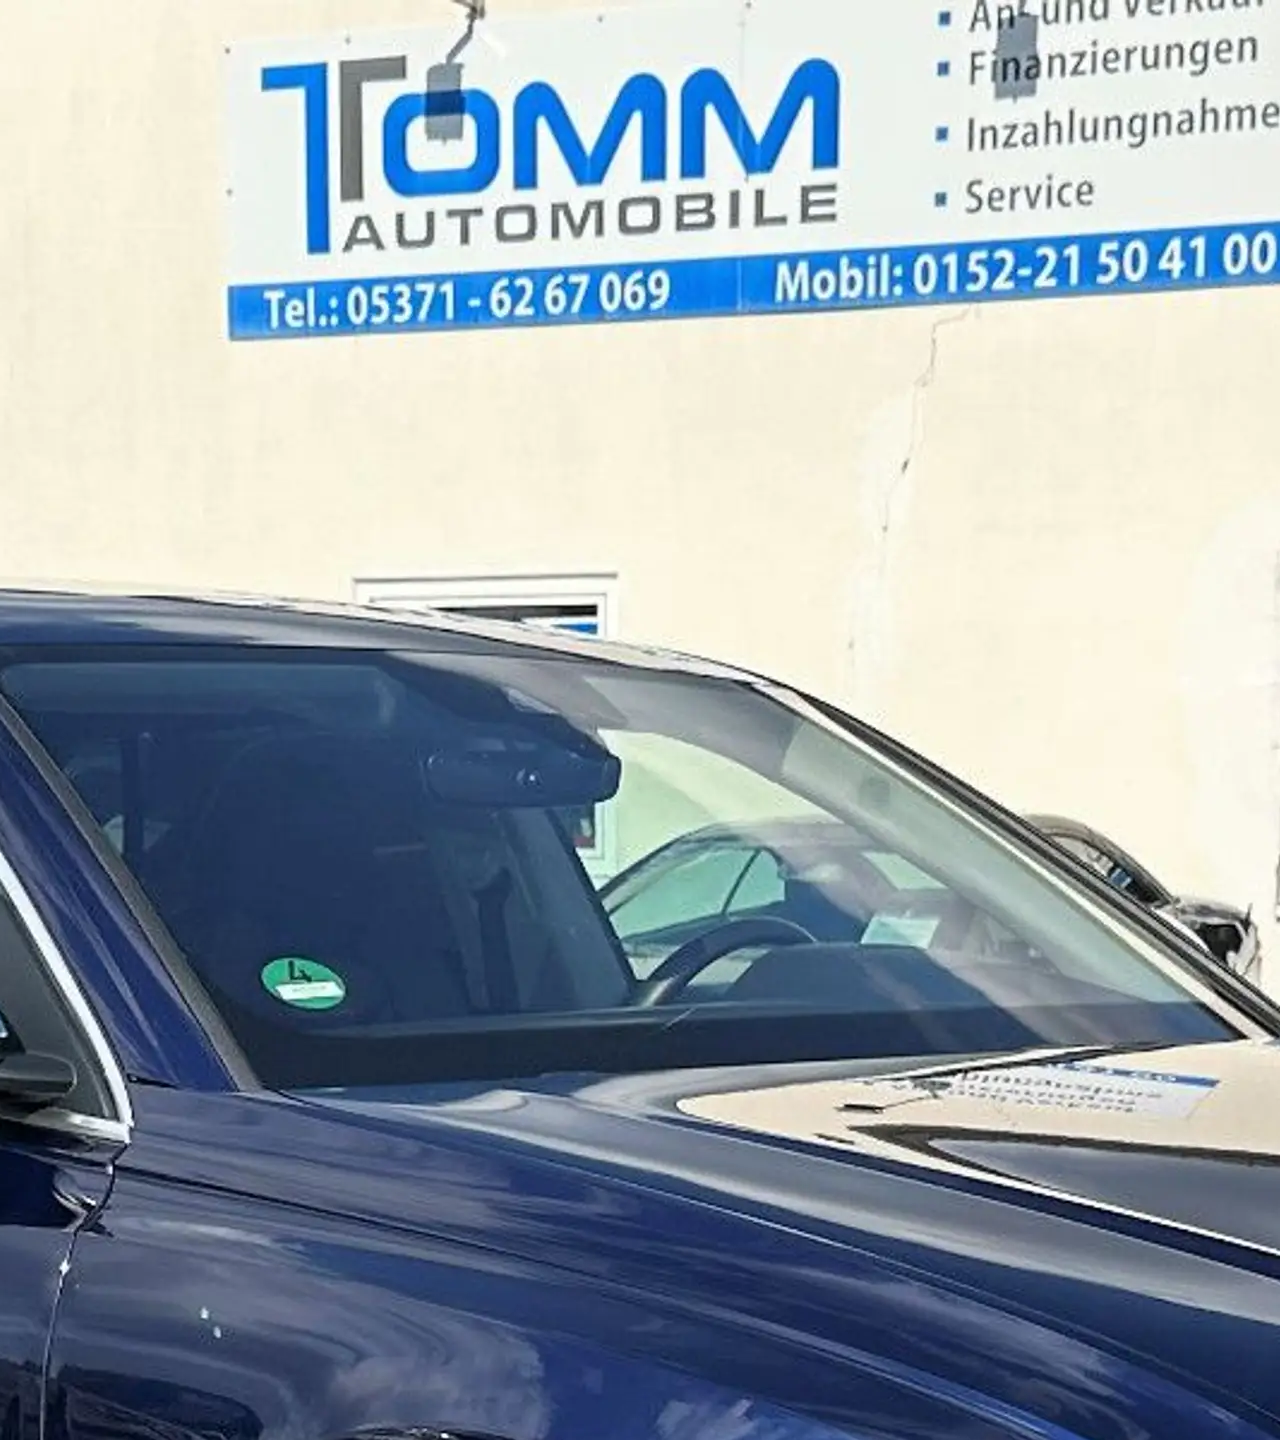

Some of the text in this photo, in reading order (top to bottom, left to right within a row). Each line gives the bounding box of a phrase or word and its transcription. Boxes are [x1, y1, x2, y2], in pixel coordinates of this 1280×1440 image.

[968, 34, 1259, 85] Finanzierungen
[261, 56, 840, 254] TOMM
[966, 98, 1280, 152] Inzahlungnahme
[342, 183, 839, 253] AUTOMOBILE
[965, 173, 1095, 214] Service
[775, 230, 1278, 302] Mobil: 0152-21 50 41 00
[263, 288, 339, 330] Tel.:
[346, 281, 456, 323] 05371
[489, 277, 535, 317] 62
[541, 273, 589, 313] 67
[599, 268, 671, 310] 069
